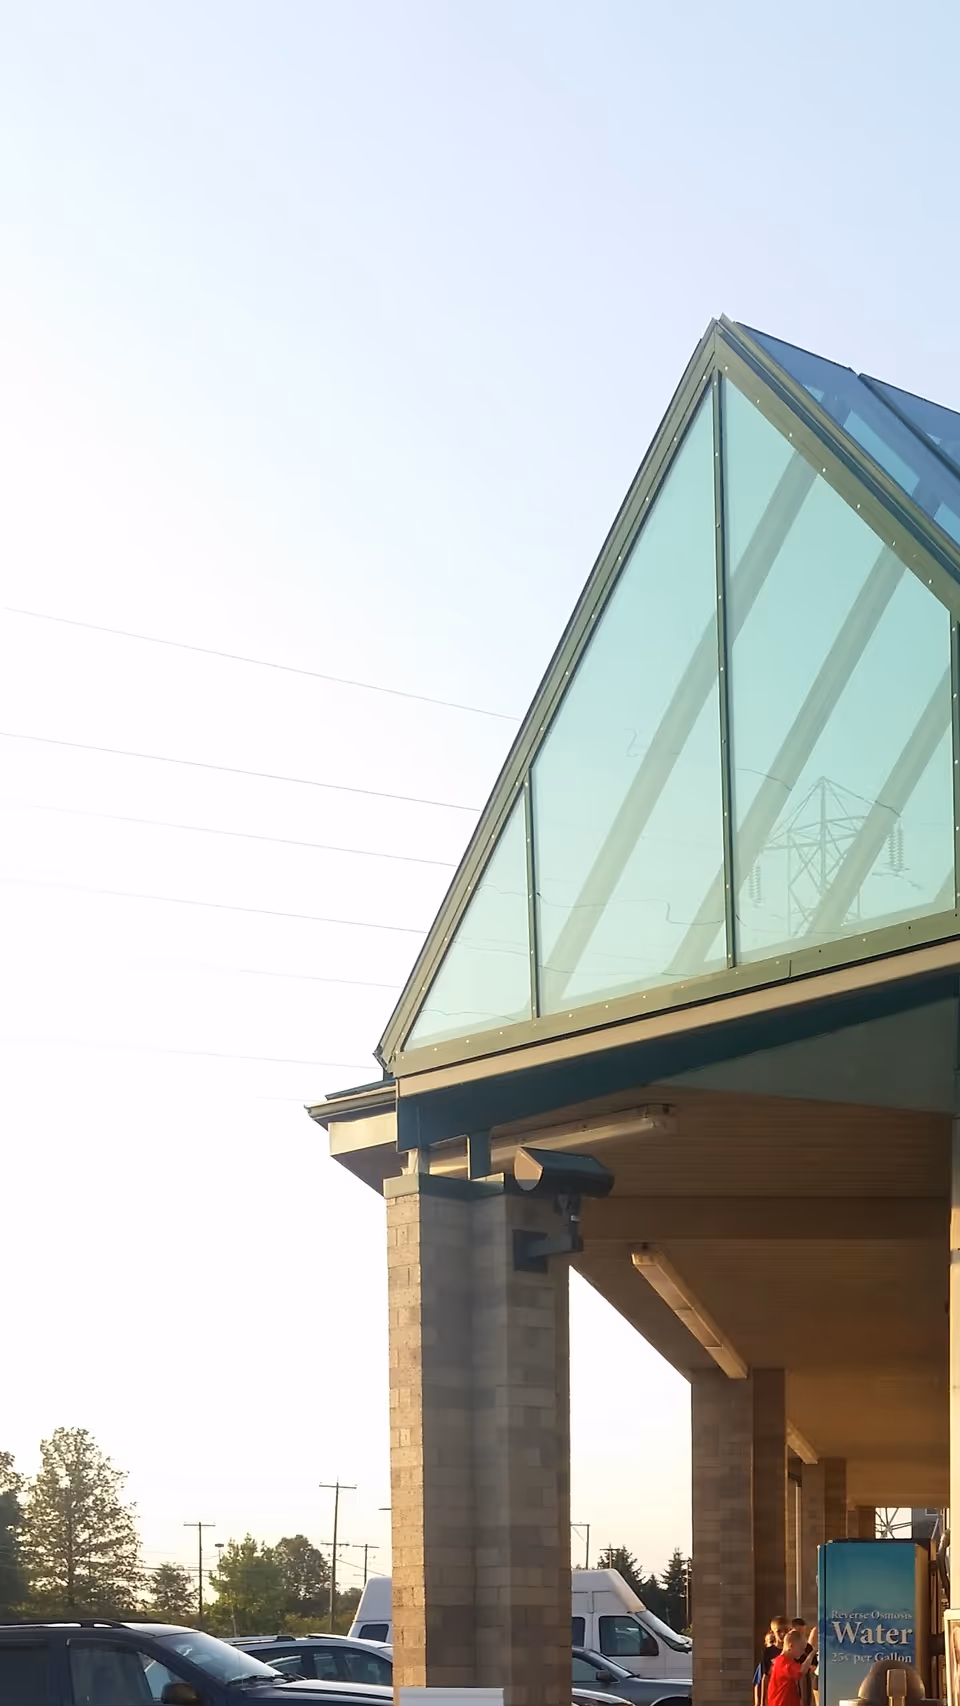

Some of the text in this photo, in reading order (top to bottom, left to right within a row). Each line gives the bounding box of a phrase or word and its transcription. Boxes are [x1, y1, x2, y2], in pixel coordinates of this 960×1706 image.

[831, 1610, 913, 1619] Reverse Osmosis
[831, 1621, 913, 1644] Water
[853, 1655, 872, 1664] per
[874, 1652, 912, 1663] Gallon
